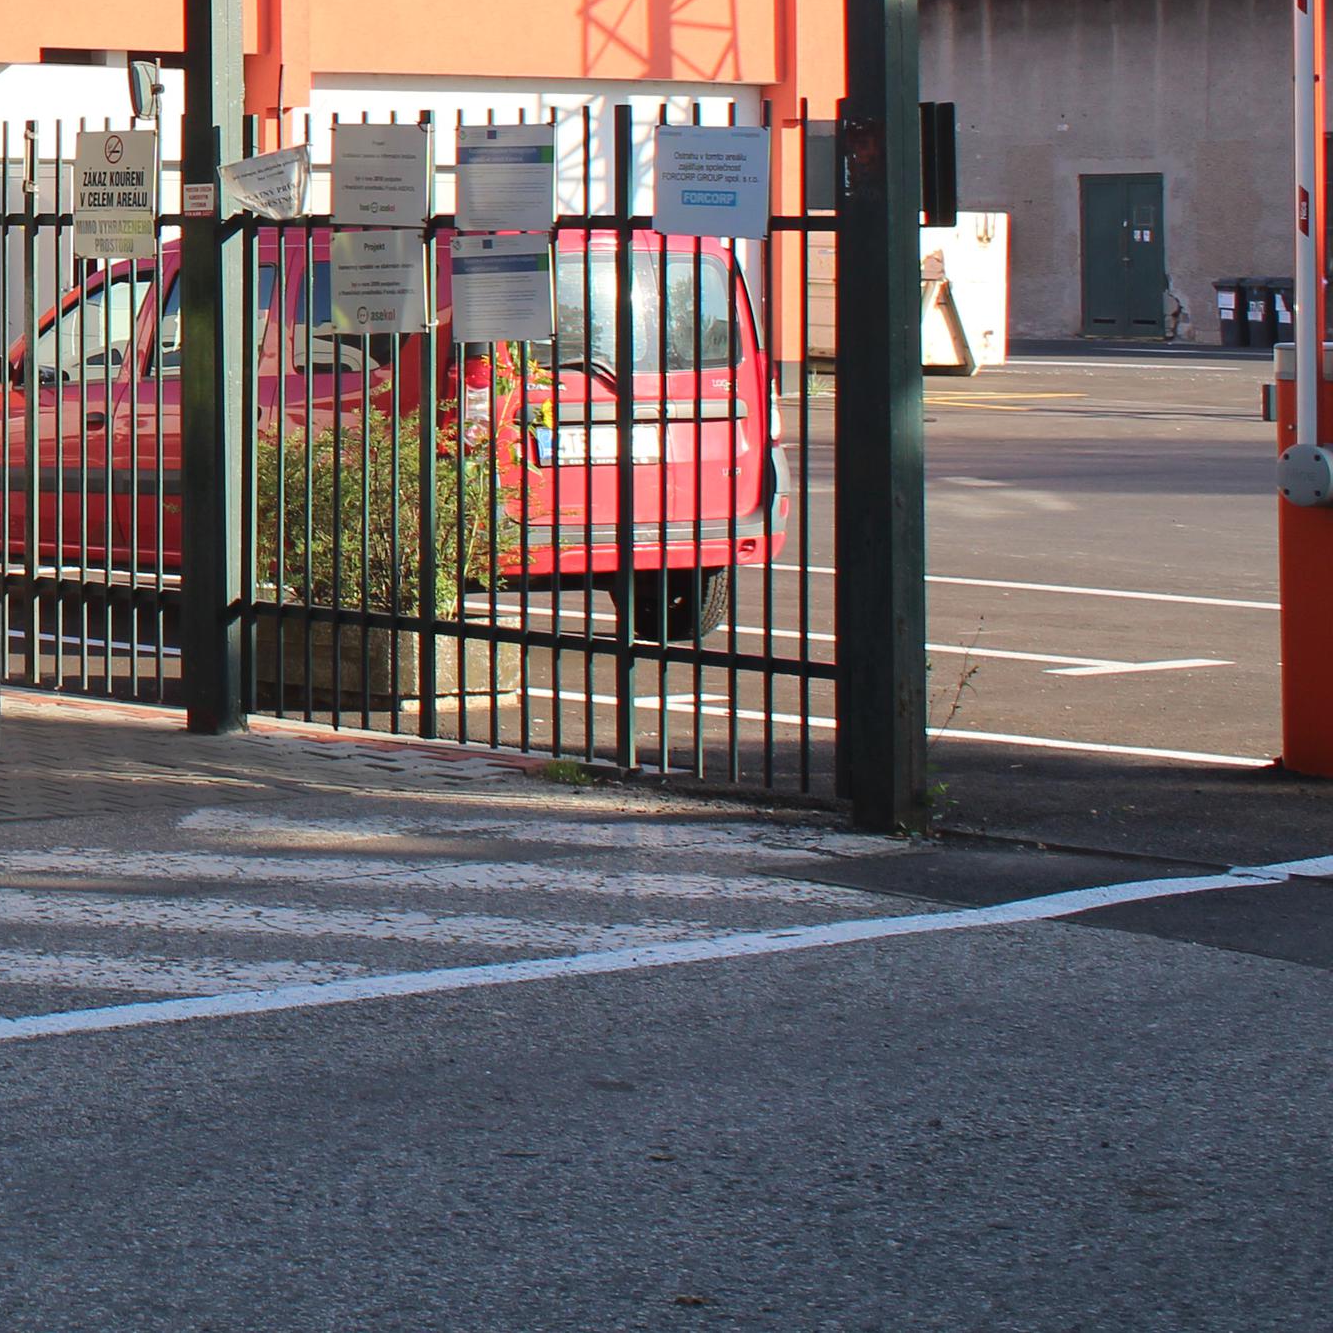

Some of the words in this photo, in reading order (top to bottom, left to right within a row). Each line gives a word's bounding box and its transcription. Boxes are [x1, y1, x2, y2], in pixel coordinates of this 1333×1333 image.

[83, 167, 107, 187] ZÁKAZ
[109, 166, 145, 187] KOUŘENÍ
[662, 172, 696, 181] FORCORP
[697, 173, 724, 182] GROUP
[80, 192, 86, 207] V
[88, 188, 114, 207] CELÉM
[116, 188, 148, 207] AREÁLU
[683, 192, 734, 204] FORCORP
[76, 220, 97, 234] MIMO
[370, 308, 396, 322] asekol
